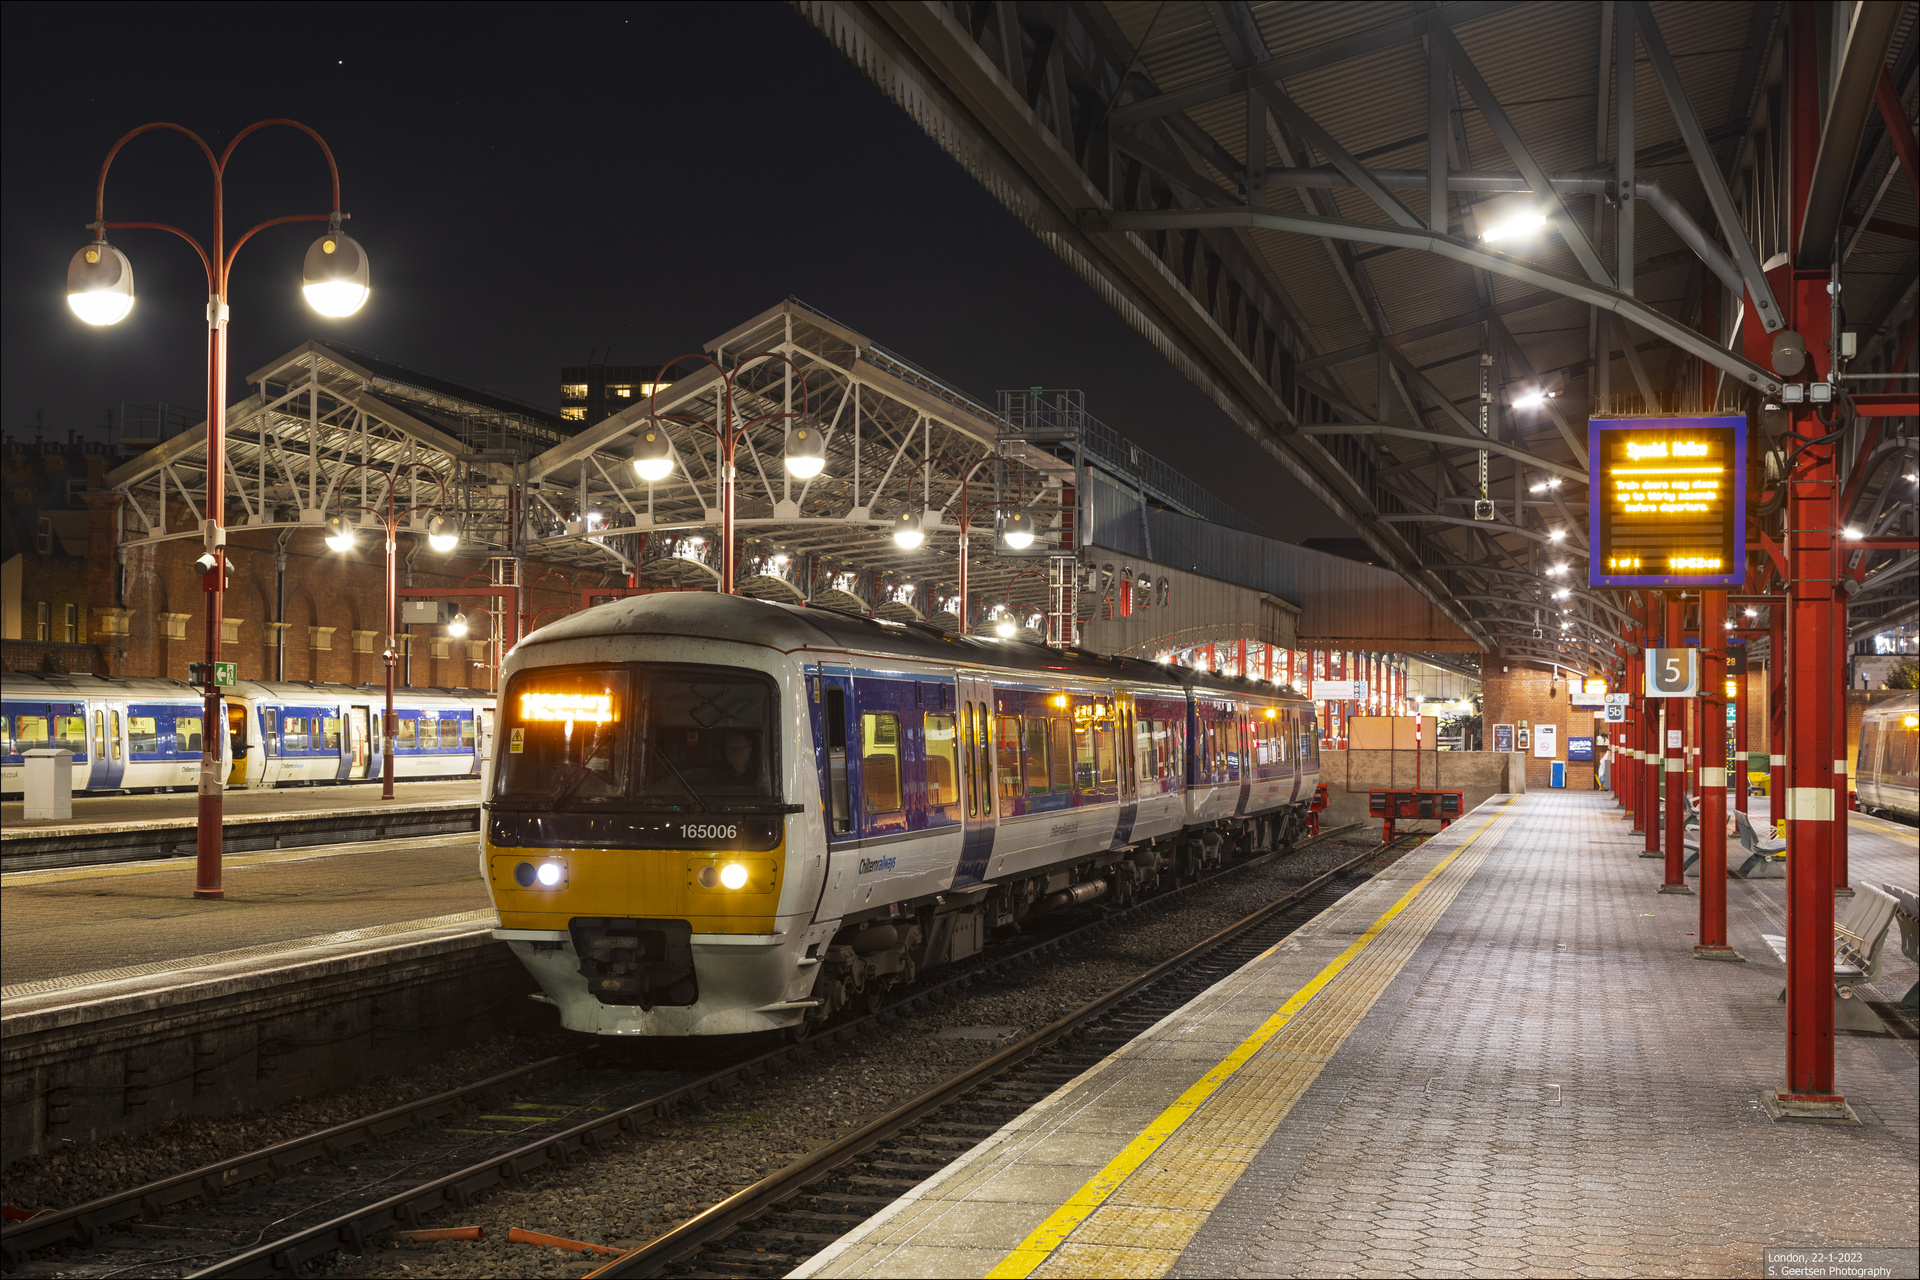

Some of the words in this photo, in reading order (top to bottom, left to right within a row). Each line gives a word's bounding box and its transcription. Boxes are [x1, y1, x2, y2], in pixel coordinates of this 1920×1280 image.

[1626, 441, 1669, 461] Special
[1672, 441, 1708, 457] Notice
[1616, 480, 1640, 490] Train
[1642, 480, 1669, 490] doors
[1671, 480, 1690, 490] may
[1692, 479, 1719, 489] close
[1617, 493, 1630, 503] up
[1632, 492, 1645, 501] to
[1647, 491, 1676, 502] thirty
[1678, 491, 1717, 500] seconds
[1625, 503, 1657, 512] before
[1659, 503, 1709, 513] departure.
[1610, 559, 1617, 568] 1
[1619, 559, 1631, 568] of
[1634, 559, 1640, 568] 1
[1664, 658, 1681, 683] 5
[1609, 706, 1621, 717] 5b
[680, 824, 737, 839] 165006
